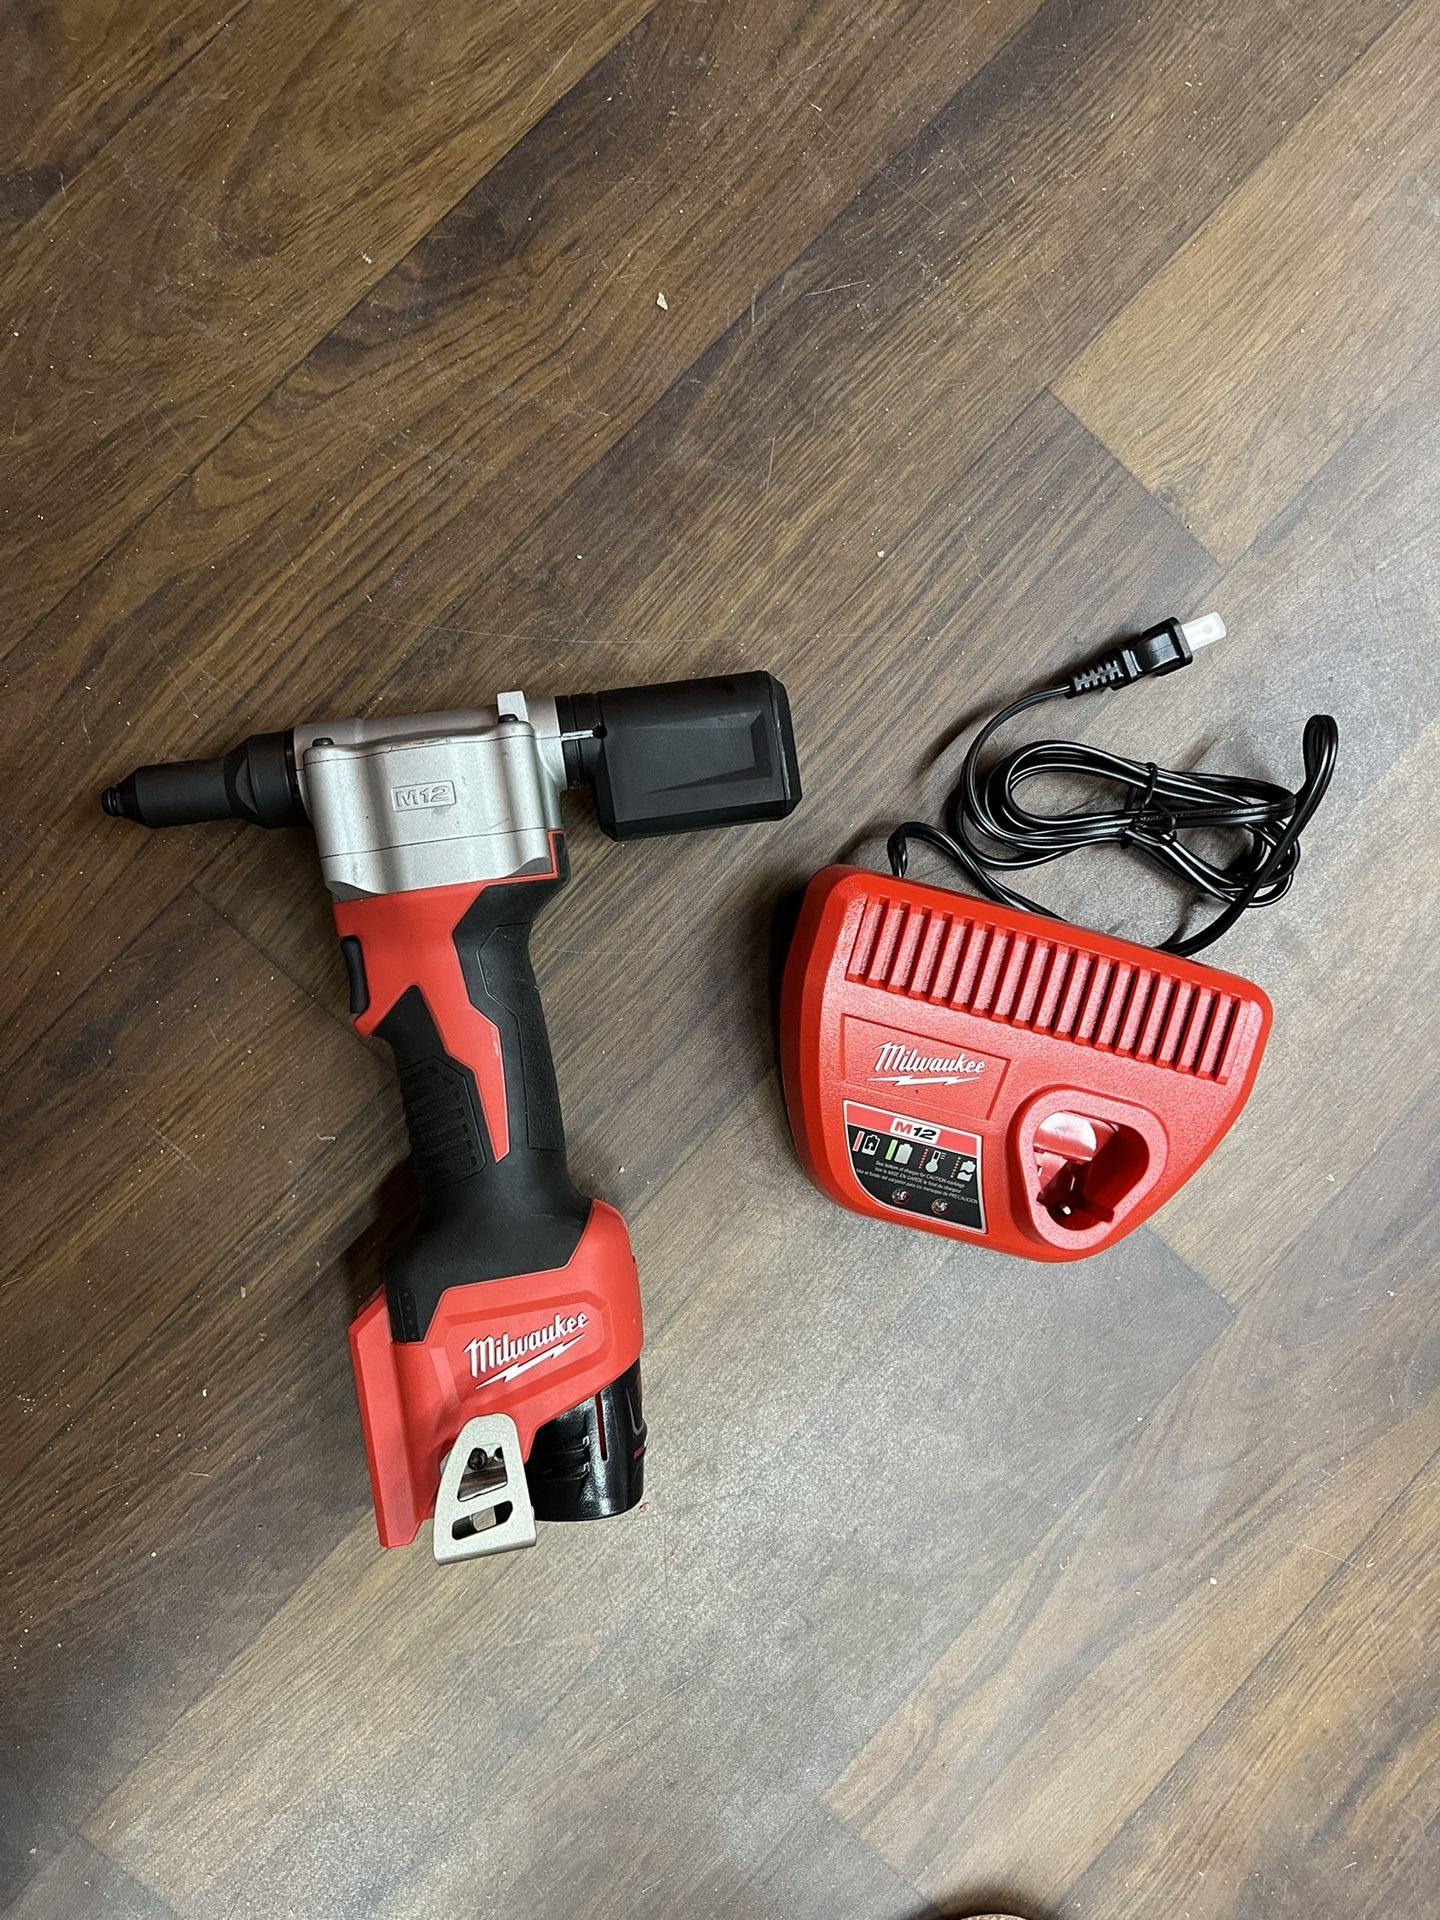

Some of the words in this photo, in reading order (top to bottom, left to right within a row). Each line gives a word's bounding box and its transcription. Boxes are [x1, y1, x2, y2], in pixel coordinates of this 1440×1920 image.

[395, 785, 450, 807] M12
[873, 1040, 985, 1073] Milwaukee
[894, 1120, 937, 1141] M12
[907, 1175, 922, 1184] GARDE
[926, 1173, 947, 1184] CAUTION
[463, 1311, 590, 1378] Milwaukee
